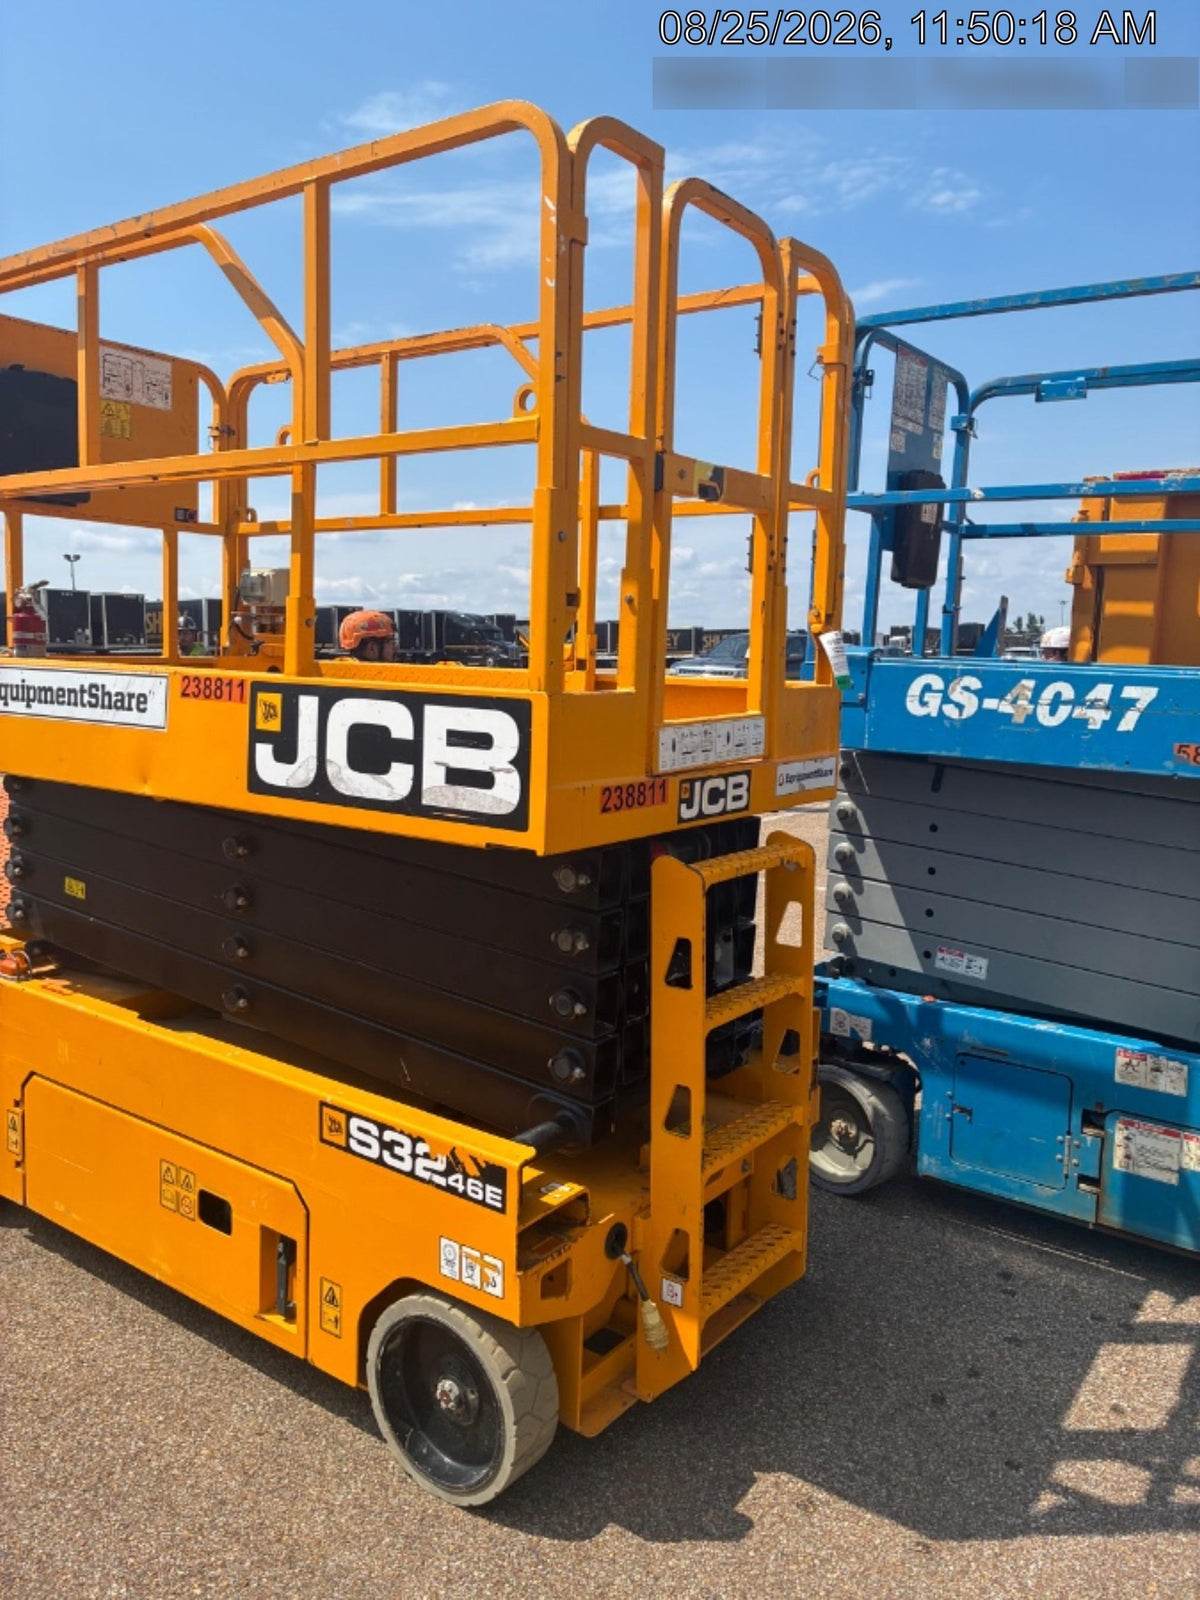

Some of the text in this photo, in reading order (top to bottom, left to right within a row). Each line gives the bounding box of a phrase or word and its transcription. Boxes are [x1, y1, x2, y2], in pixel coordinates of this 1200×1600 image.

[181, 675, 246, 702] 238811
[905, 673, 1159, 732] GS-4047
[255, 694, 521, 816] JCB
[601, 779, 667, 814] 238811
[680, 774, 749, 819] JCB
